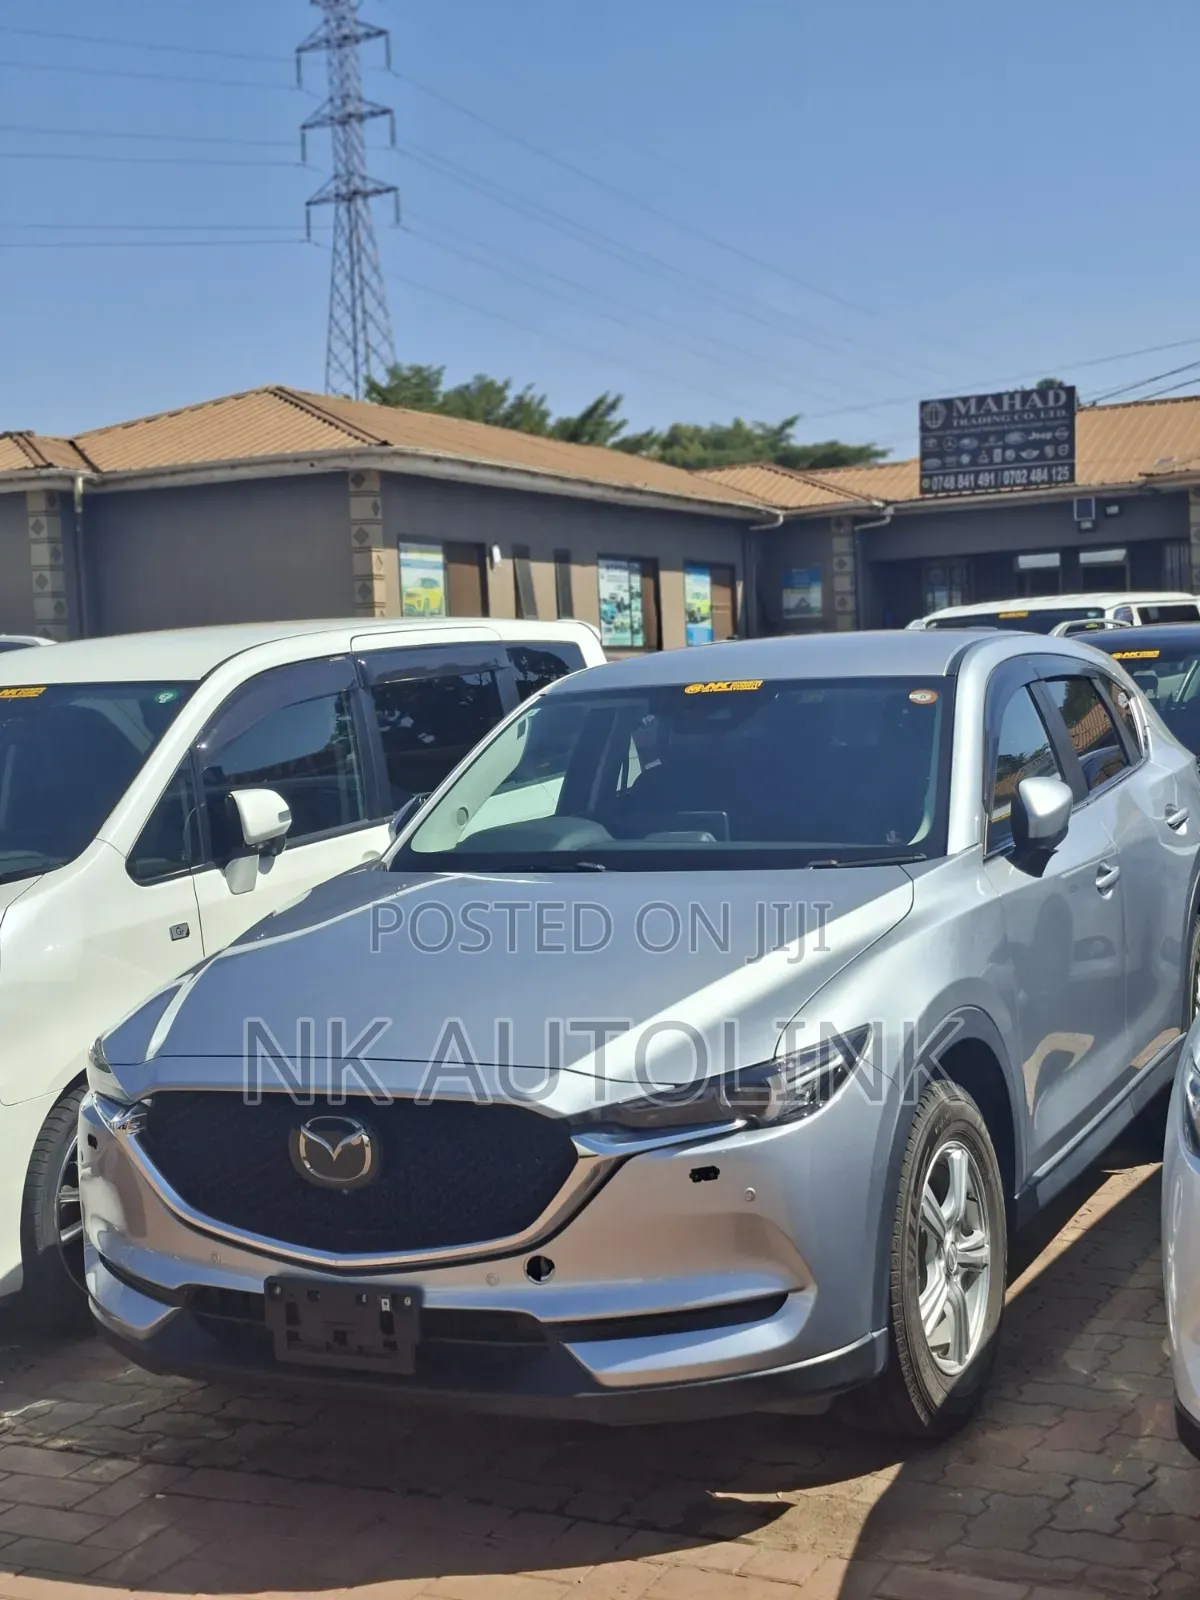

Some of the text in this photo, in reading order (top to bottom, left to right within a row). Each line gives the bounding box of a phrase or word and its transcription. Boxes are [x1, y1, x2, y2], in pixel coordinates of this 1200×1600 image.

[952, 389, 1067, 417] MAHAD
[952, 409, 1069, 427] TRADING CO. LTD.
[1003, 469, 1028, 485] 0702
[1051, 464, 1070, 481] 125
